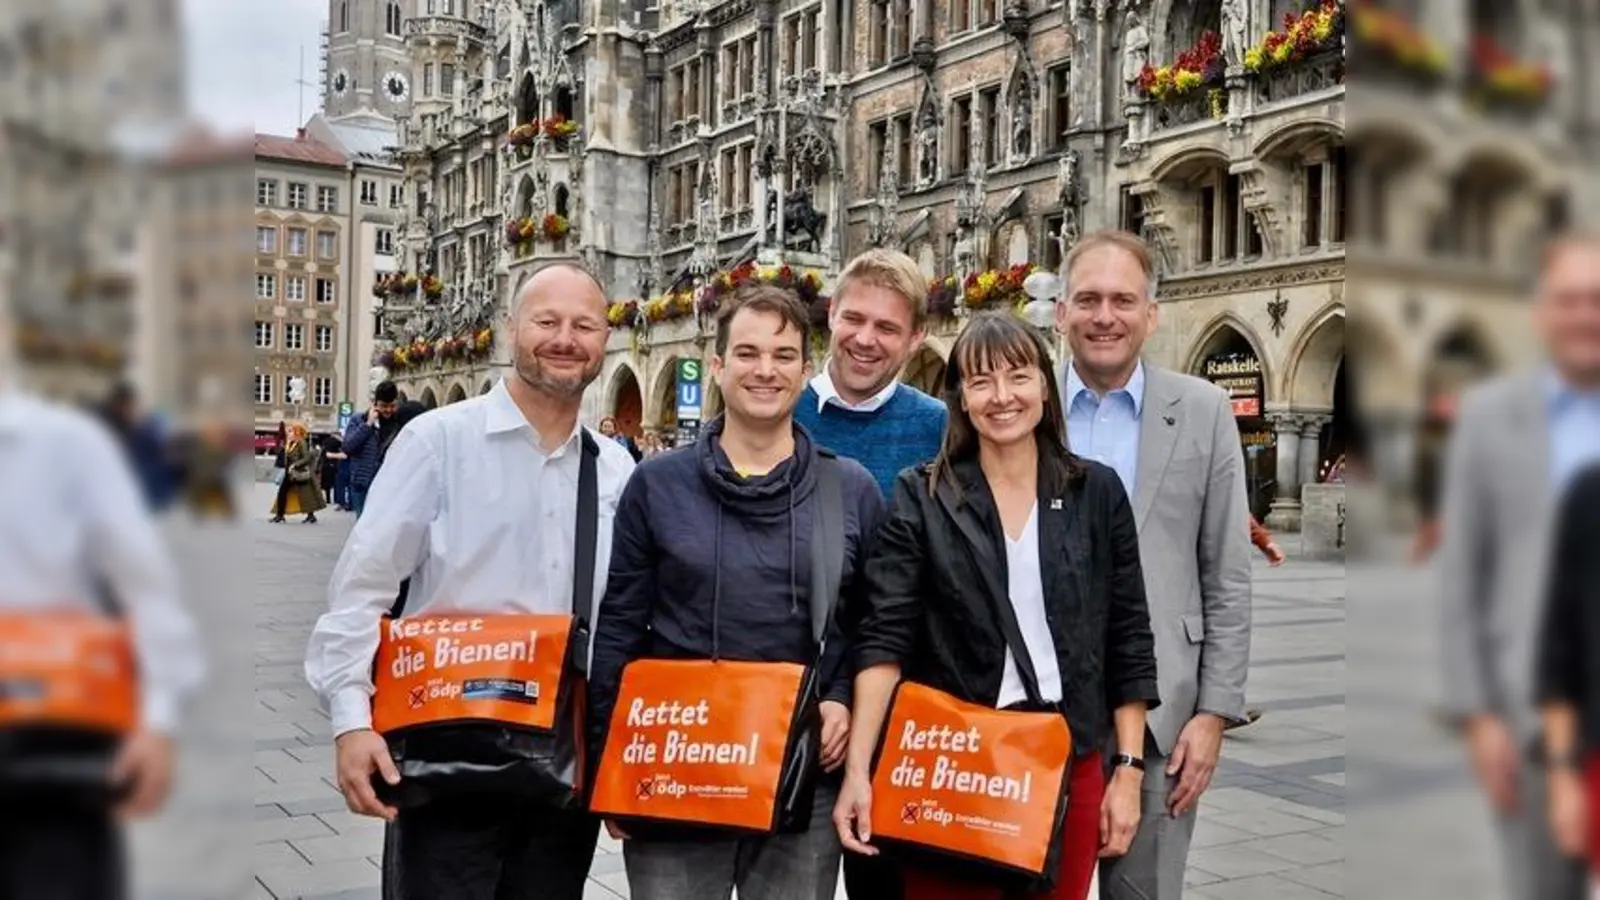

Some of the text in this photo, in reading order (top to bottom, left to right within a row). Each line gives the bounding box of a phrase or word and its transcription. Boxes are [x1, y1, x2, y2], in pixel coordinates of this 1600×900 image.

[682, 361, 698, 380] S
[1207, 358, 1261, 375] Ratskelle
[682, 384, 696, 405] U
[341, 403, 352, 415] S
[389, 617, 484, 642] Rettet
[391, 629, 538, 679] die Bienen!
[429, 681, 462, 699] ödp
[626, 697, 709, 727] Rettet
[899, 719, 981, 753] Rettet
[623, 730, 759, 766] die Bienen!
[657, 779, 687, 799] ödp
[890, 754, 1032, 803] die Bienen!
[923, 807, 954, 827] ödp
